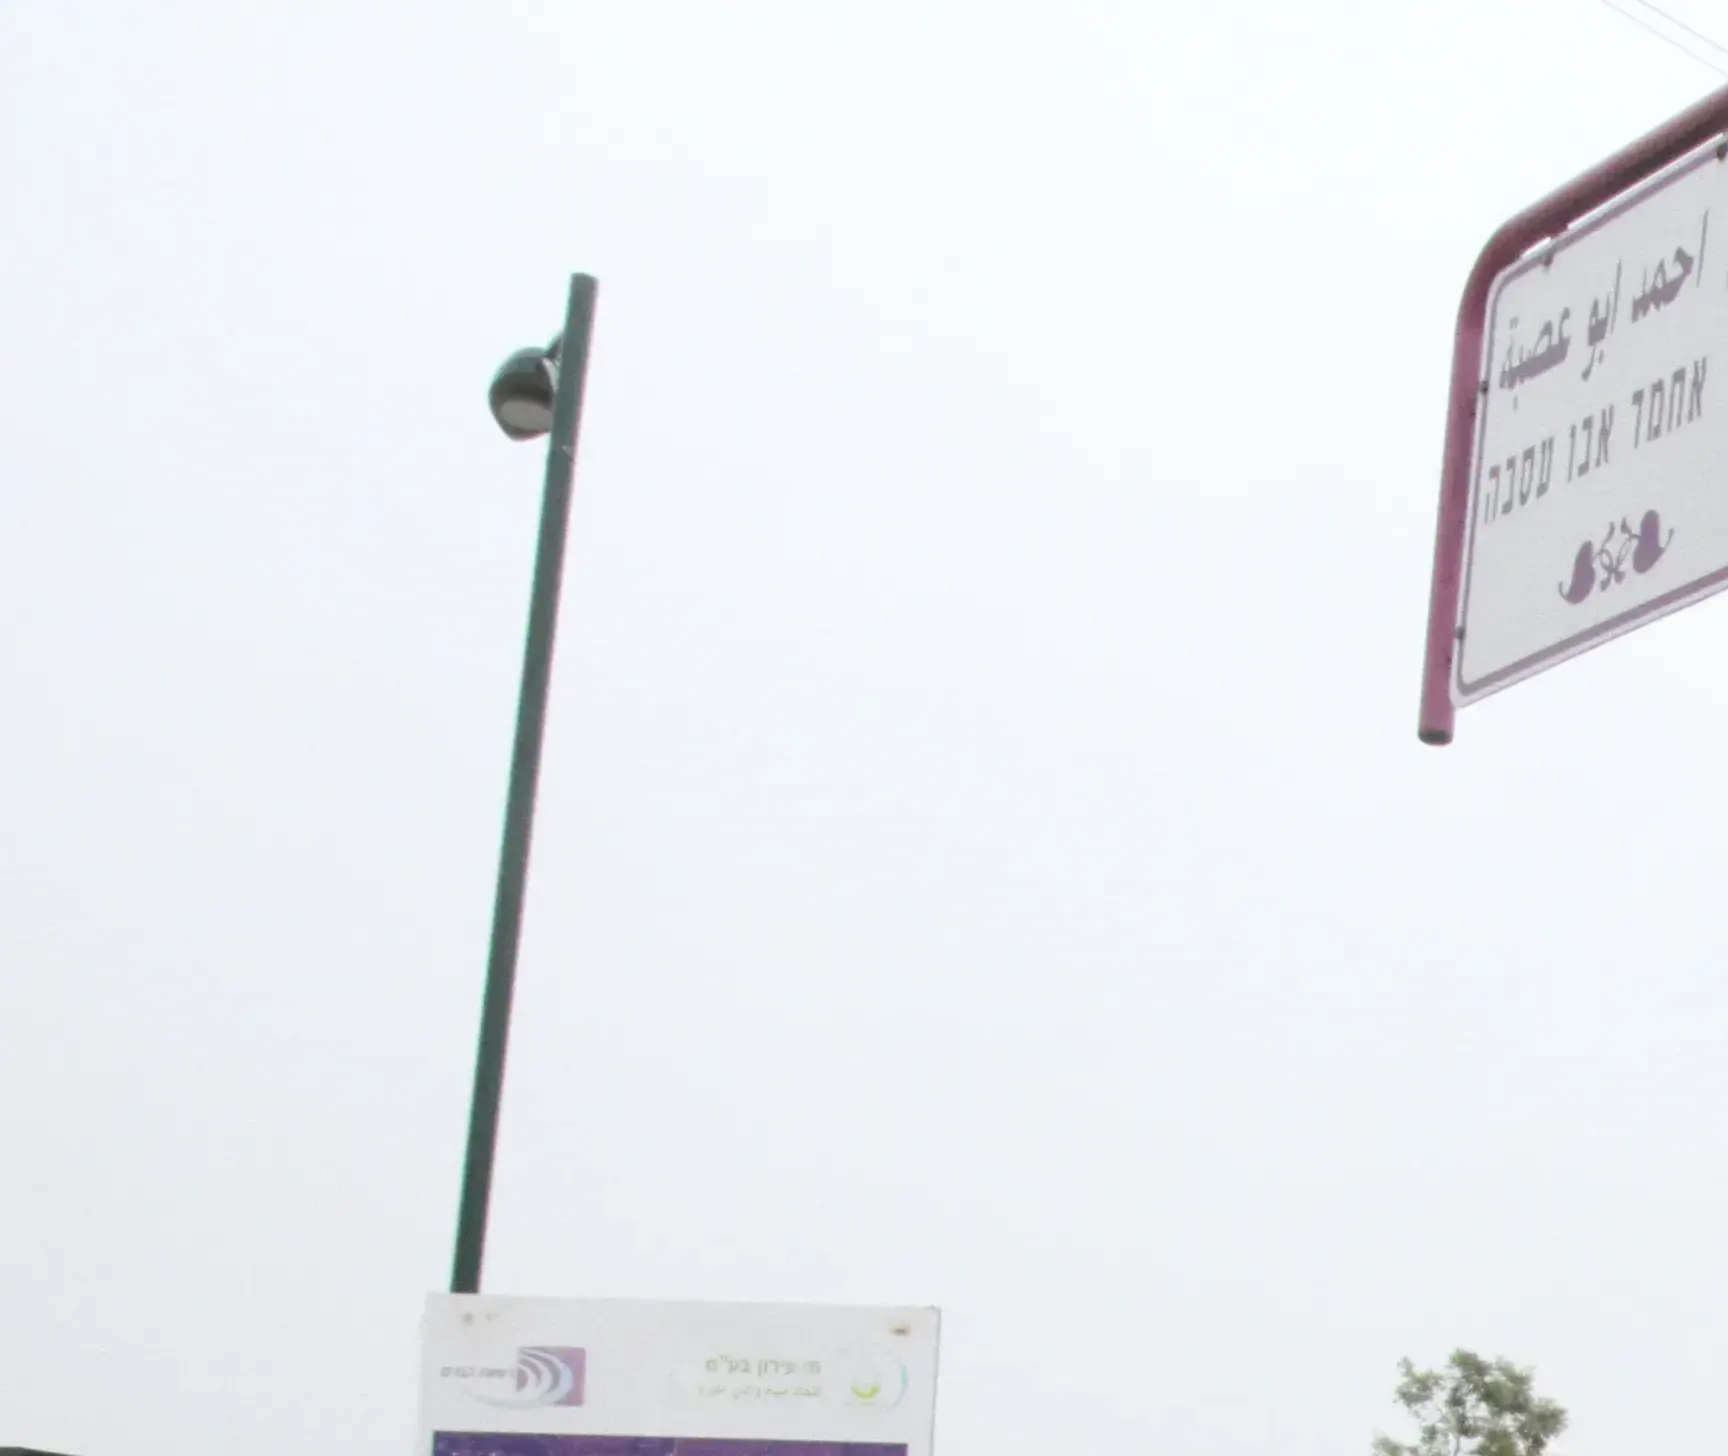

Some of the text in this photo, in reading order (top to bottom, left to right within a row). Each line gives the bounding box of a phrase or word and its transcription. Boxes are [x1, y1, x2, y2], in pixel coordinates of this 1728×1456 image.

[1566, 404, 1615, 485] אבו
[1630, 355, 1708, 451] אחמד
[1483, 432, 1555, 526] עסבה
